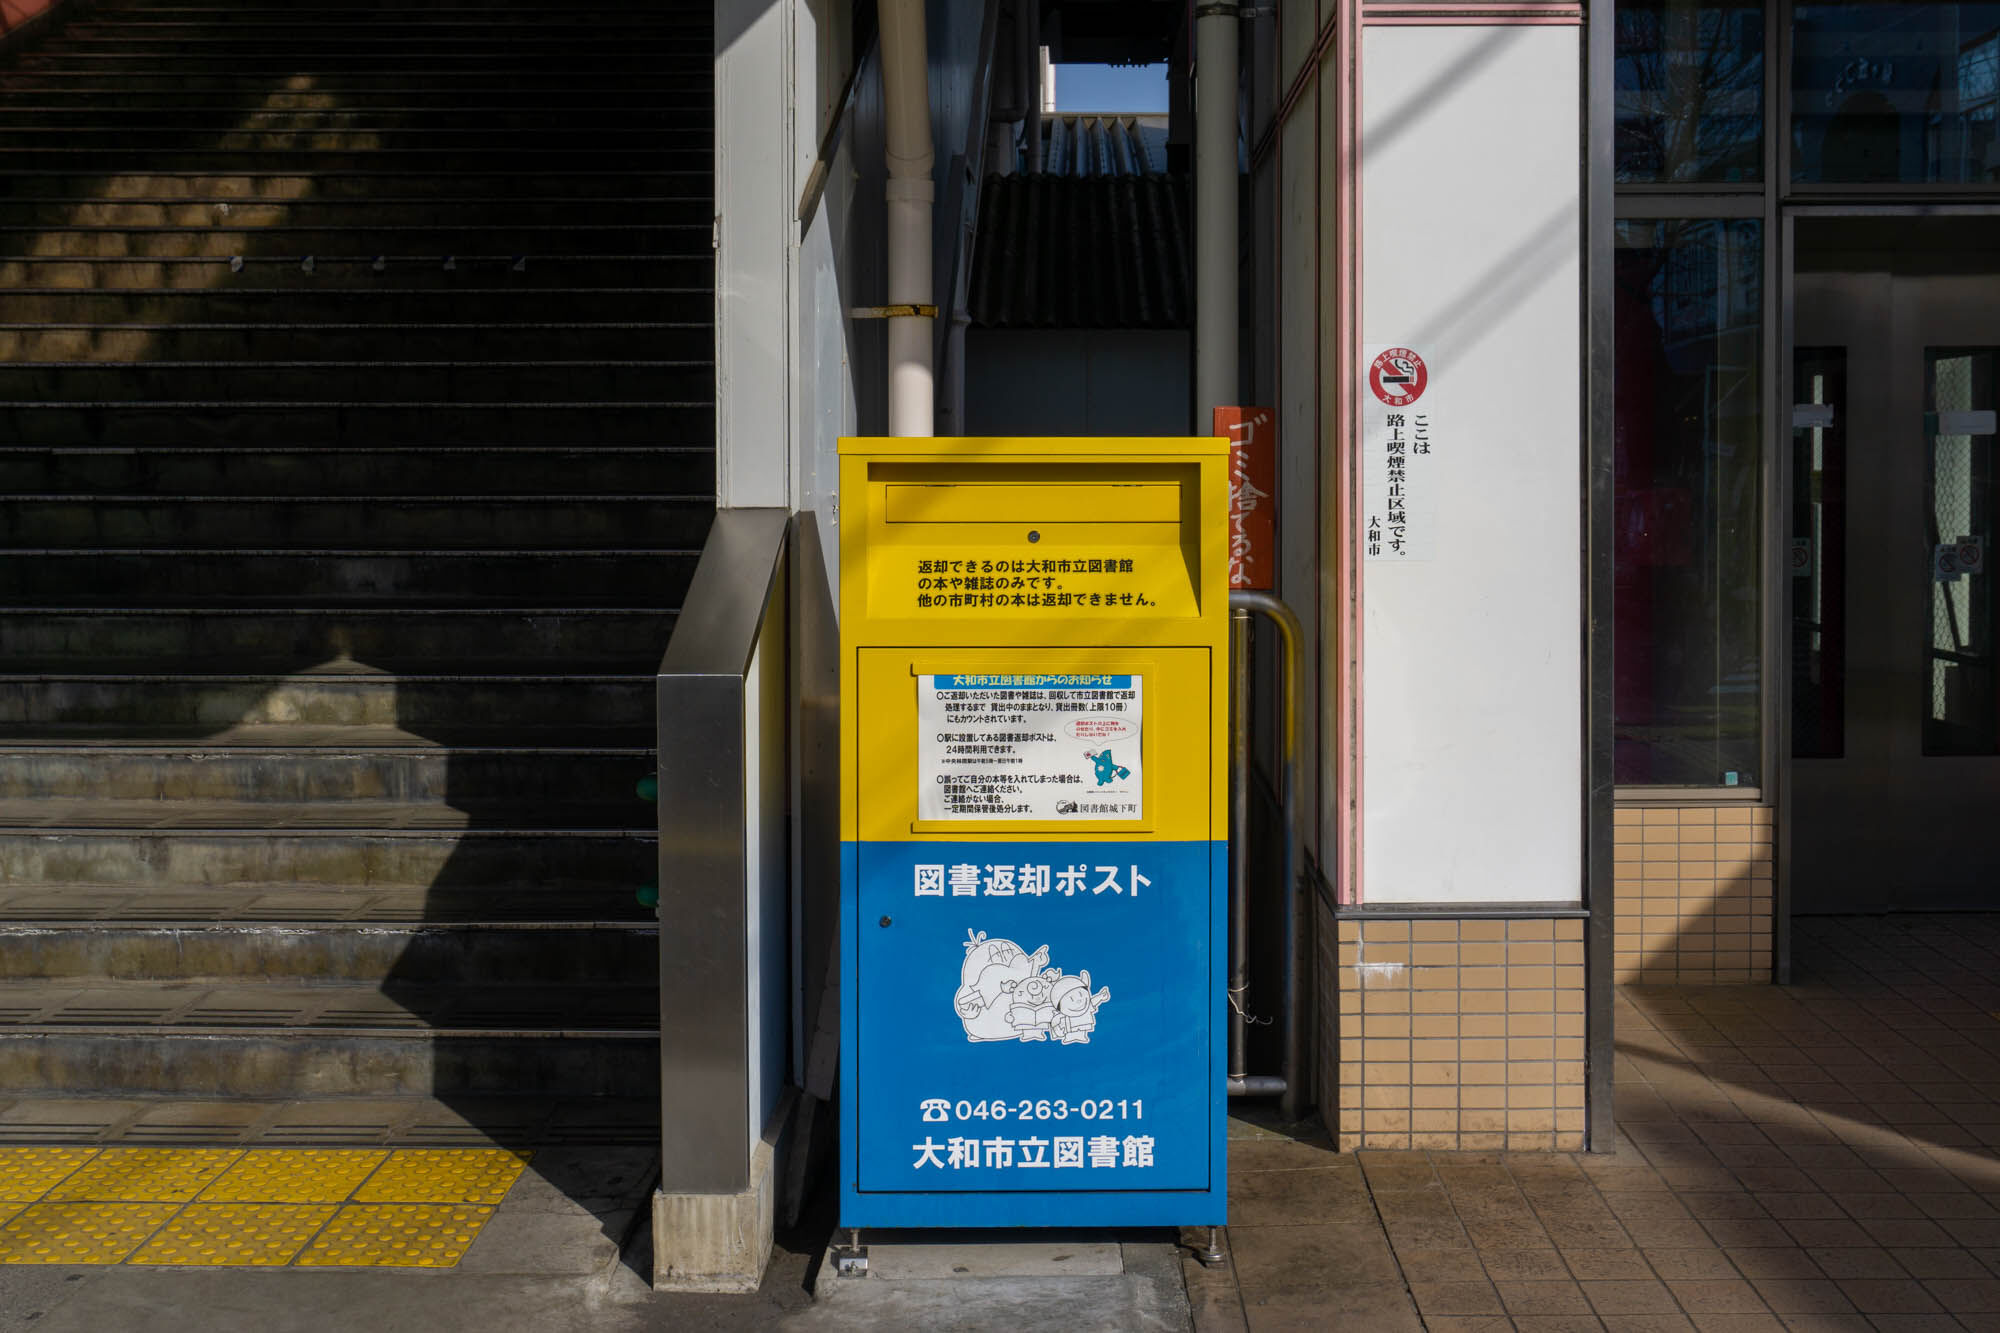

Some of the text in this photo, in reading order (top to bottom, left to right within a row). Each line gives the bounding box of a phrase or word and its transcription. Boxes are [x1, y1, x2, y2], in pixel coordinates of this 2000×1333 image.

[1374, 349, 1422, 368] 路上喫煙禁止
[1382, 393, 1414, 405] 大和市
[1413, 414, 1431, 455] ここは
[1386, 414, 1407, 556] 路上喫煙禁止区域です。
[1229, 413, 1270, 585] ゴミ捨てるな
[1368, 515, 1381, 556] 大和市
[917, 559, 1134, 574] 返却できるのは大和市立図書館
[918, 576, 1064, 591] の本や雑誌のみです。
[917, 592, 1157, 608] 他の市町村の本は返却できません。
[953, 675, 1112, 686] 大和市立図書館からのお知らせ
[947, 715, 1028, 723] にもカウントされています。
[946, 745, 1016, 754] 24時間利用できます。
[943, 785, 1023, 794] 図書館へご連絡ください。
[943, 804, 1034, 814] 一定期間保管後処分します。
[1080, 804, 1137, 813] 図書館城下町
[914, 863, 1152, 897] 図書返却ポスト
[955, 1099, 1143, 1120] 046-263-0211
[912, 1135, 1155, 1169] 大和市立図書館
